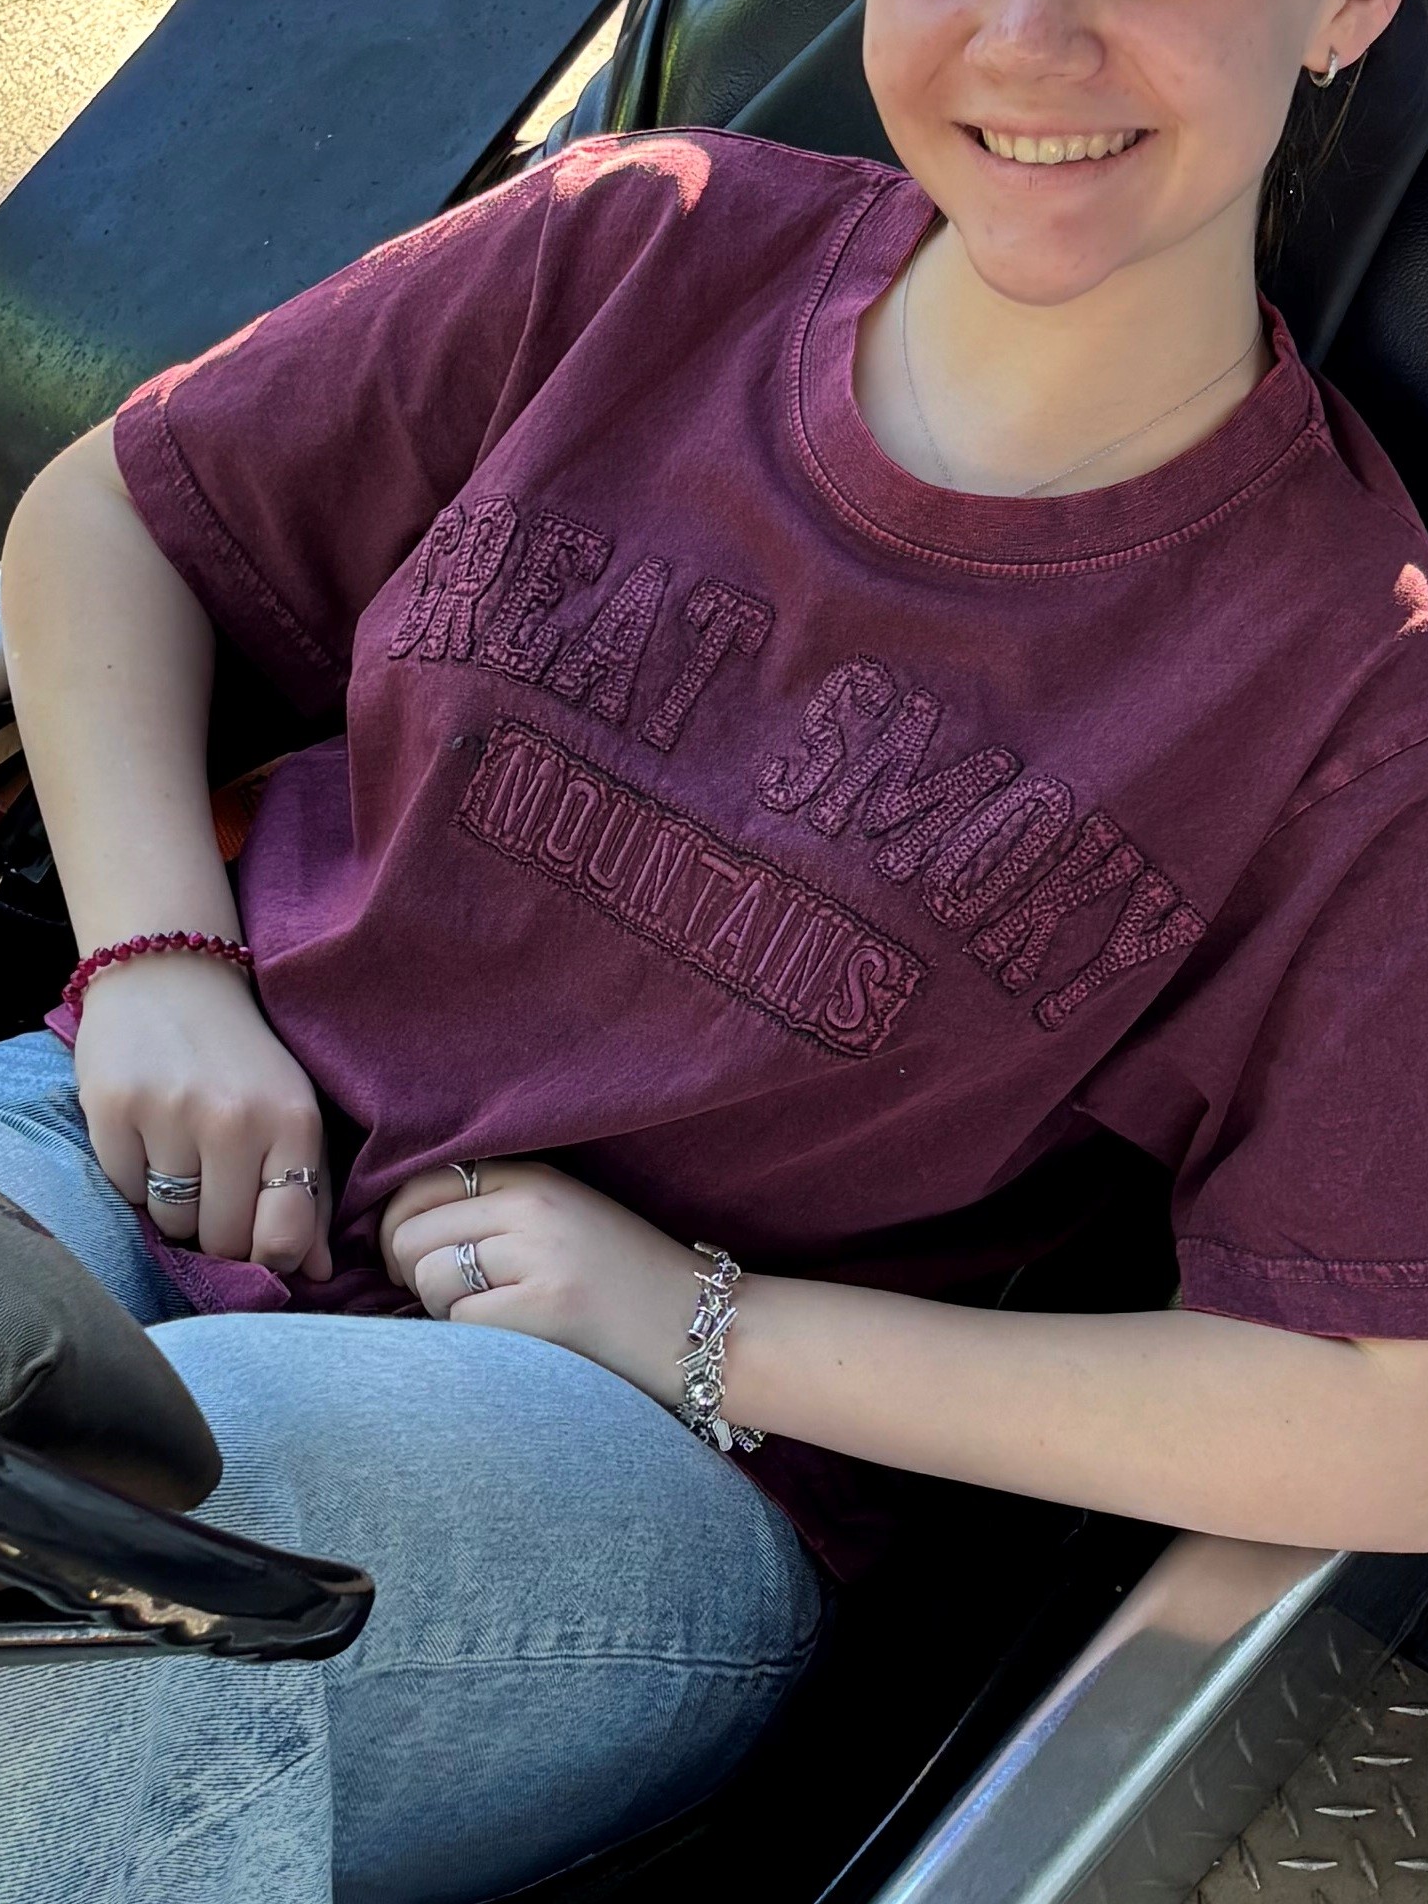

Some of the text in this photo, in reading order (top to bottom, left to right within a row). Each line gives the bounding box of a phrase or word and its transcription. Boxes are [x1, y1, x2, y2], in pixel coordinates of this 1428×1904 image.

[387, 494, 1207, 1031] GREAT SMOKY
[486, 745, 890, 1030] MOUNTAINS
